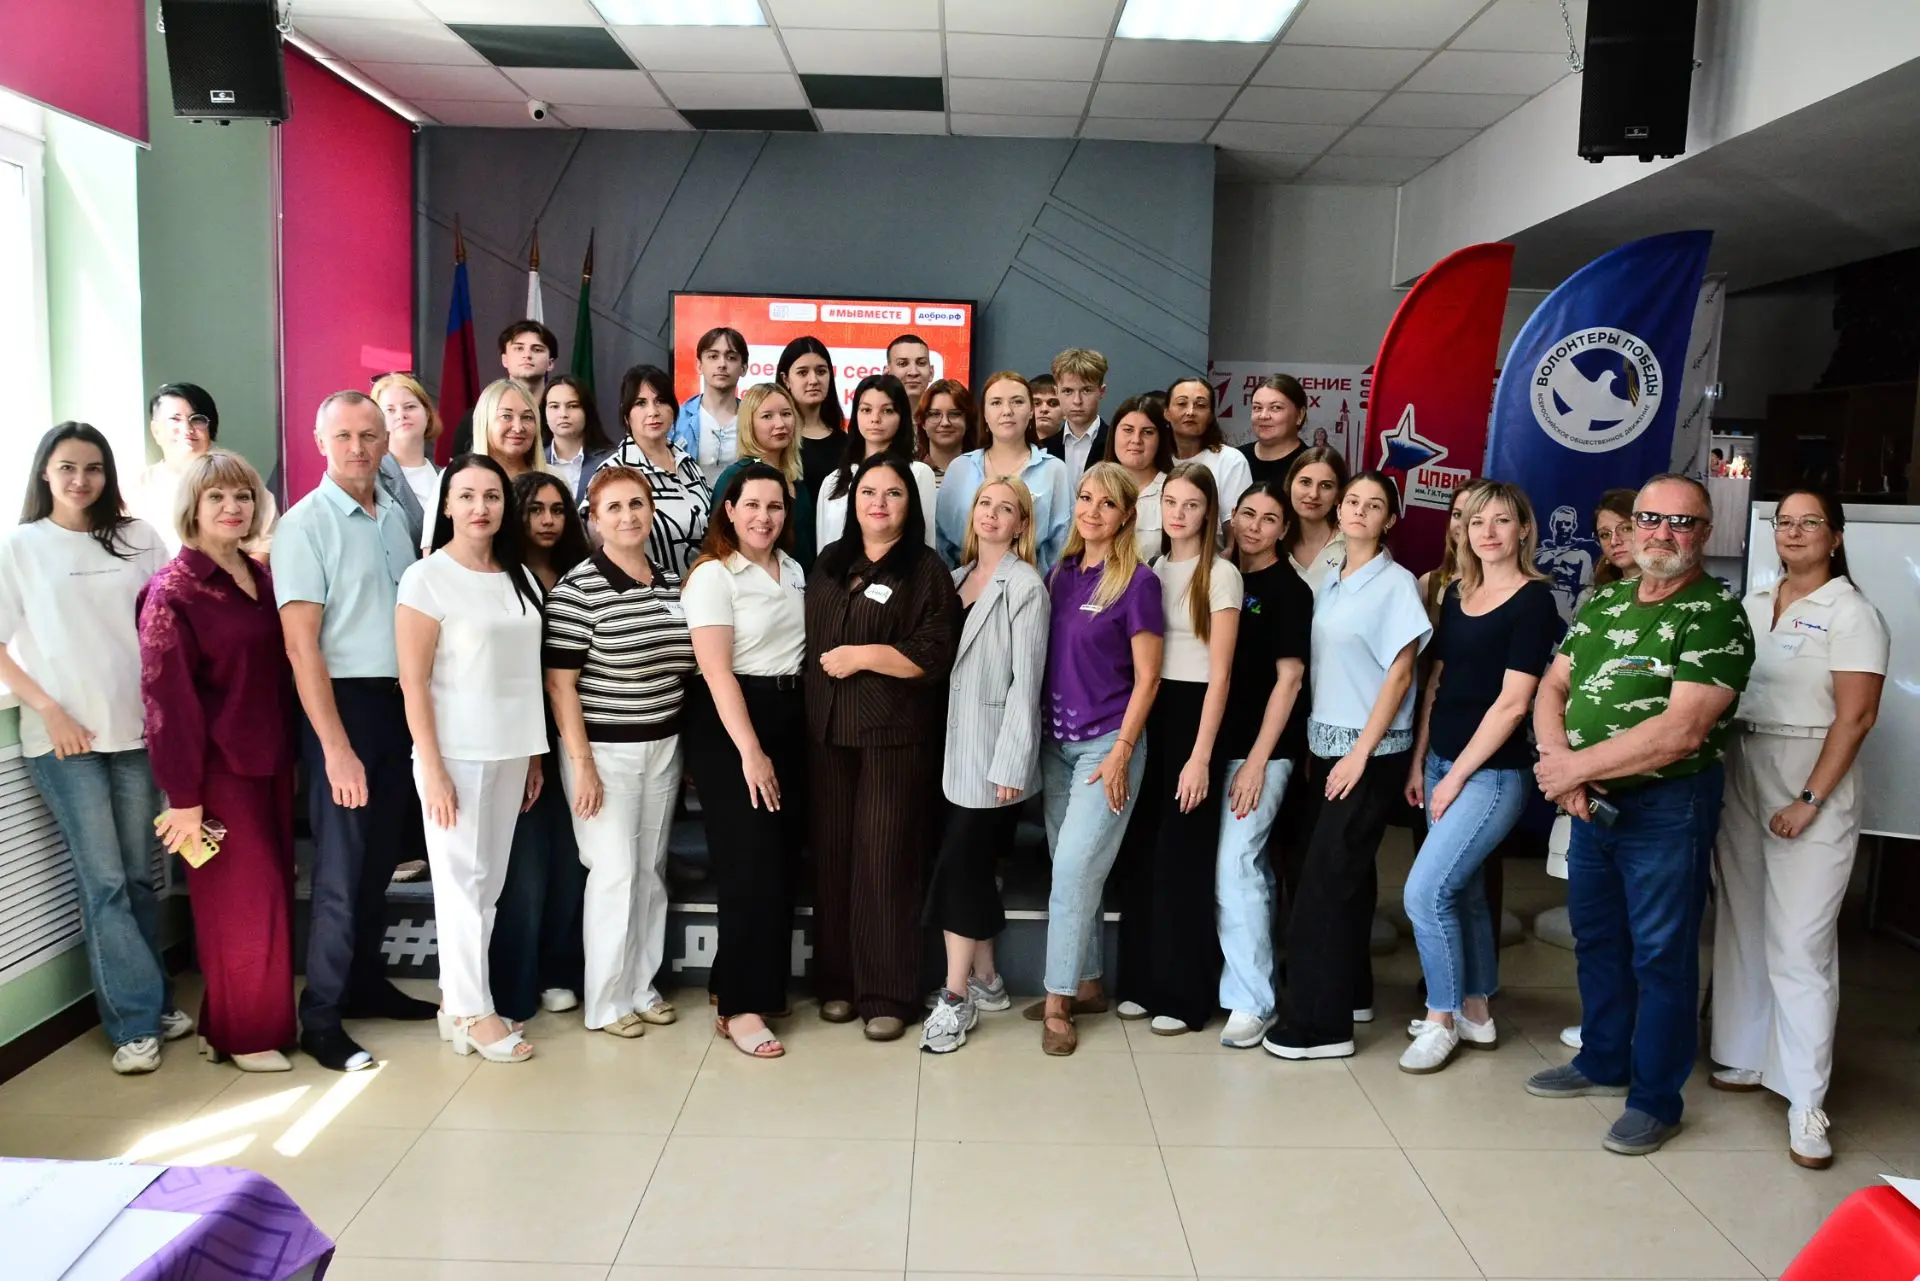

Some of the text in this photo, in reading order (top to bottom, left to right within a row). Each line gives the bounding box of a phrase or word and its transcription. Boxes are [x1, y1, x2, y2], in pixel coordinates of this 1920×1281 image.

[829, 308, 902, 320] #МЫВМЕСТЕ
[918, 311, 962, 321] добро.рф
[1536, 332, 1620, 387] ВОЛОНТЕРЫ
[1622, 338, 1658, 396] ПОБЕДЫ
[1243, 375, 1352, 391] ДВЕНИЕ
[1537, 392, 1570, 440] ВСЕРОССИЙСКОЕ
[1570, 433, 1624, 446] ОБЩЕСТВЕННОЕ
[1624, 403, 1650, 436] ДВИЖЕНИЕ
